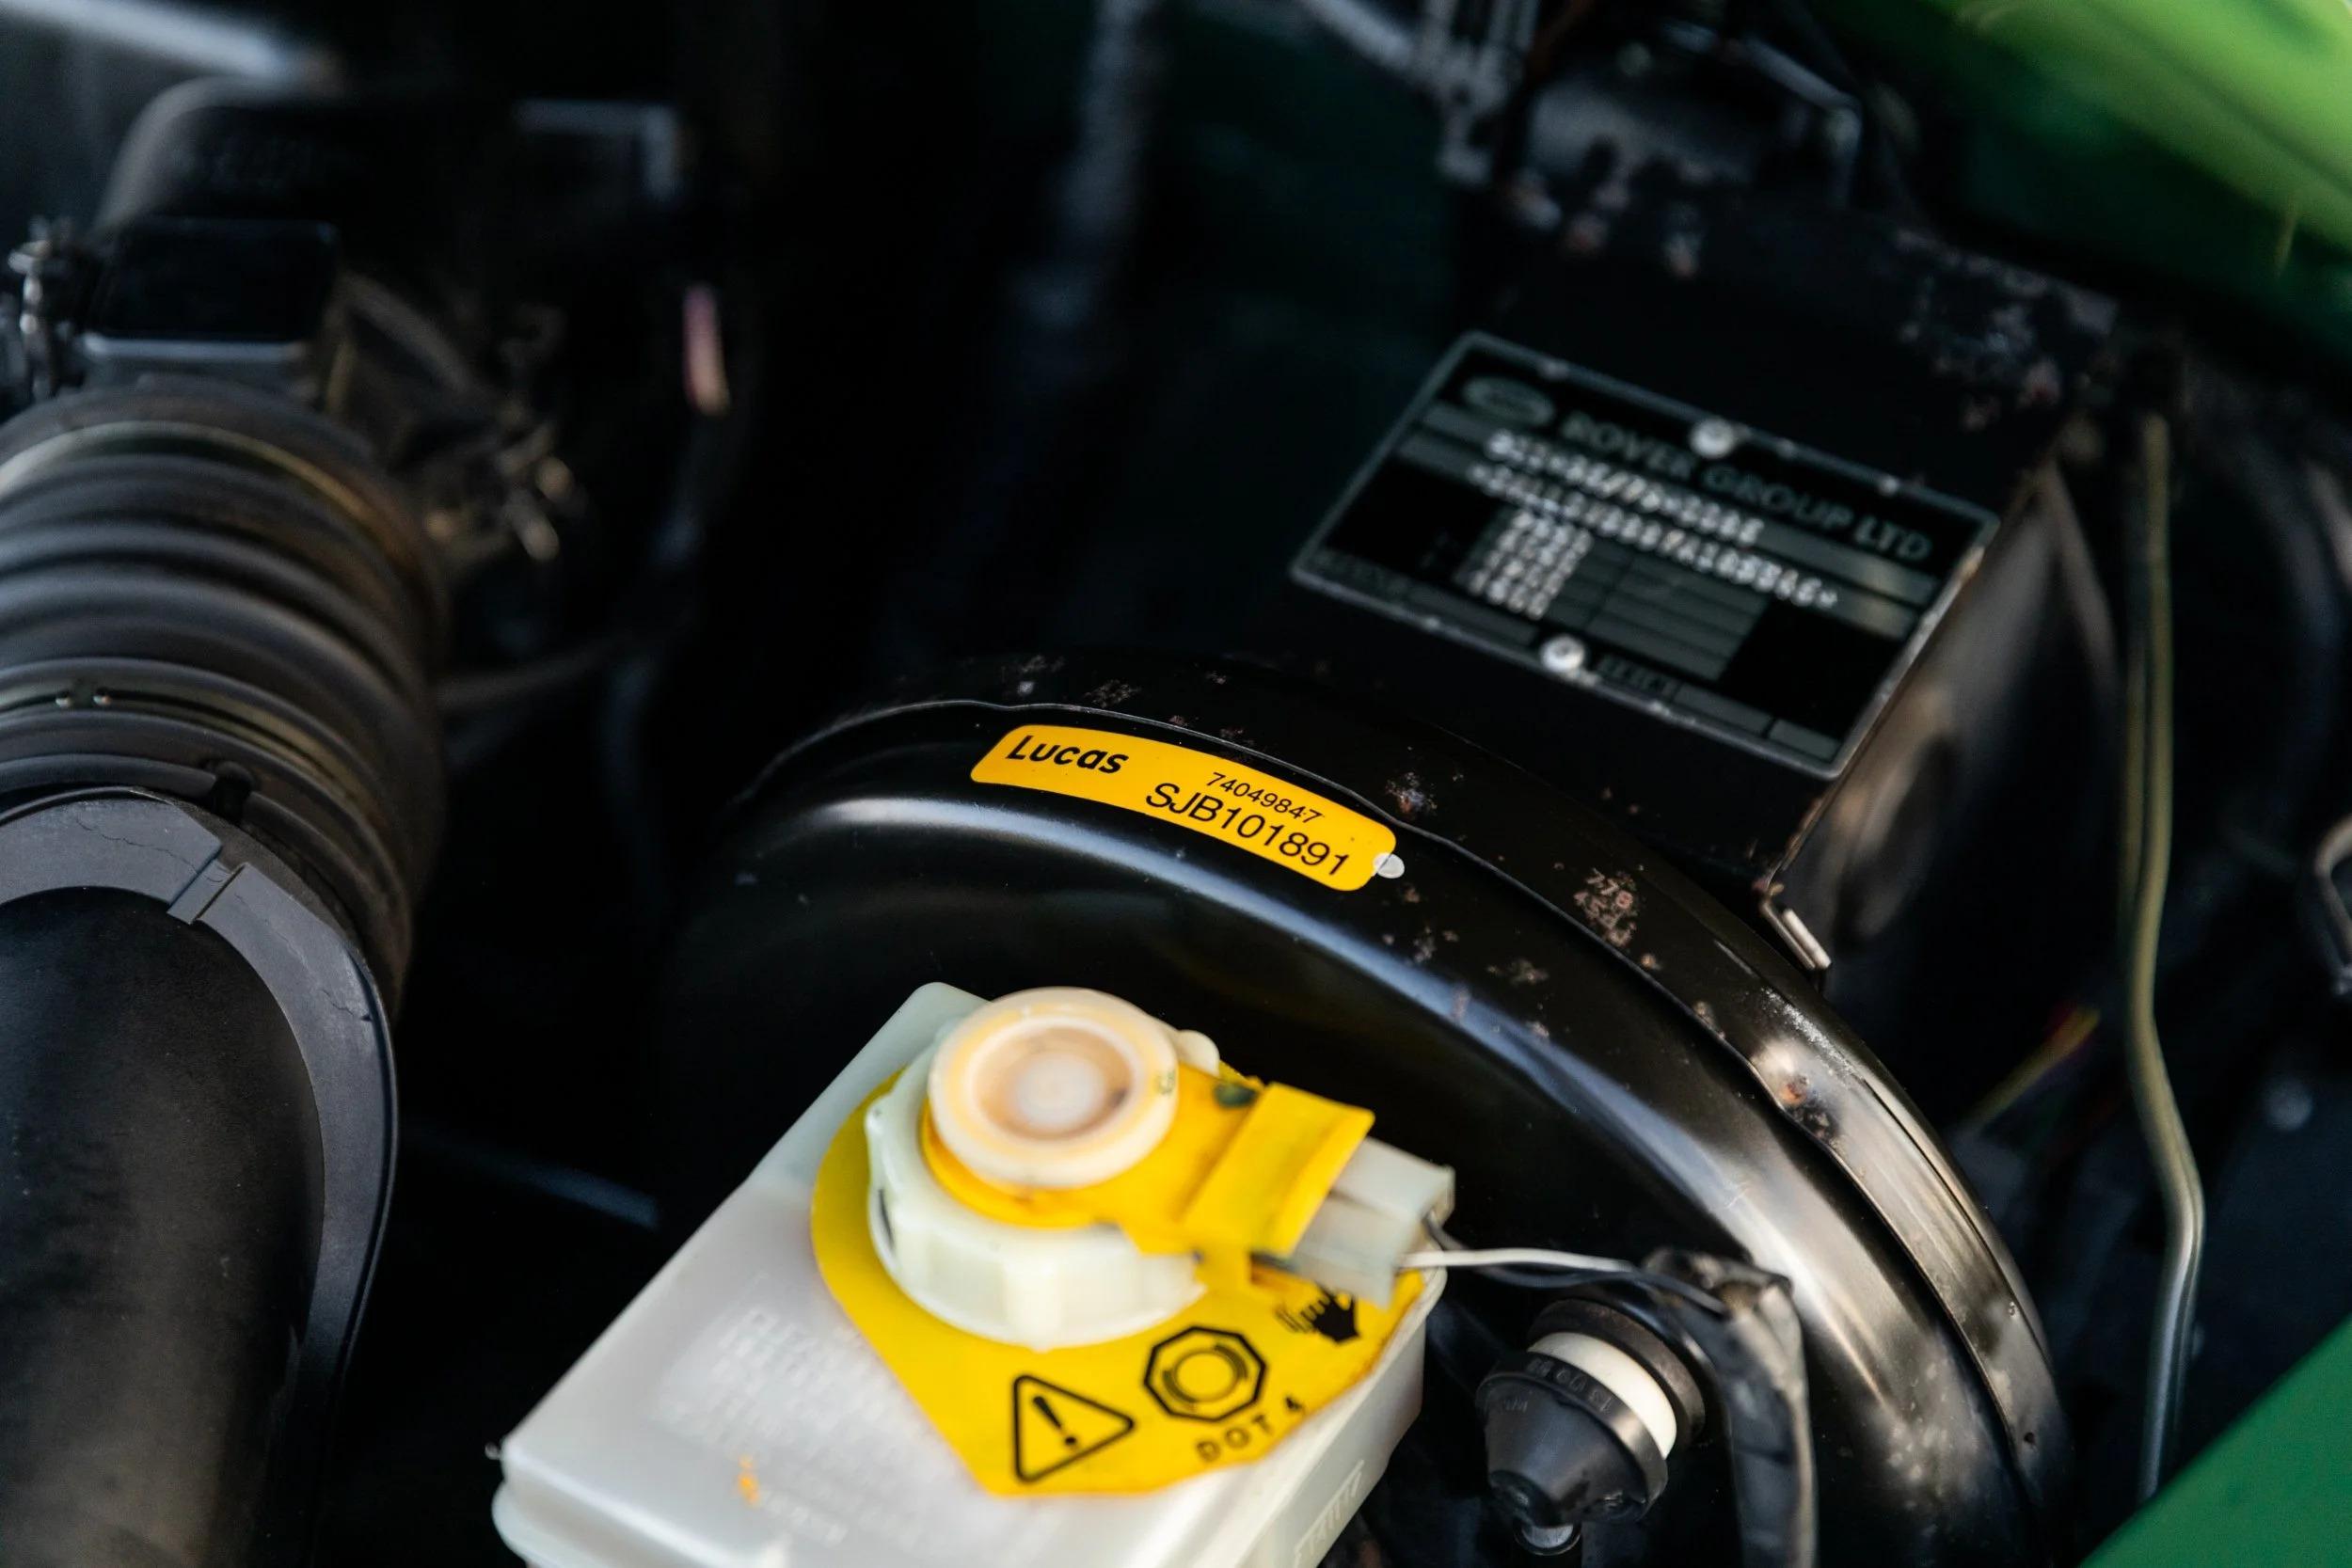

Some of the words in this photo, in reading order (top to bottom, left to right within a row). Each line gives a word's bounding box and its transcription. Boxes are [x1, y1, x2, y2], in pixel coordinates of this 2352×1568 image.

[1561, 409, 1693, 478] ROVER
[1702, 462, 1853, 530] GROUP
[1855, 515, 1934, 562] LTD
[1006, 736, 1130, 774] Lucas
[1206, 771, 1323, 823] 74049847
[1145, 783, 1350, 876] SJB101891
[1196, 1415, 1270, 1463] DOT
